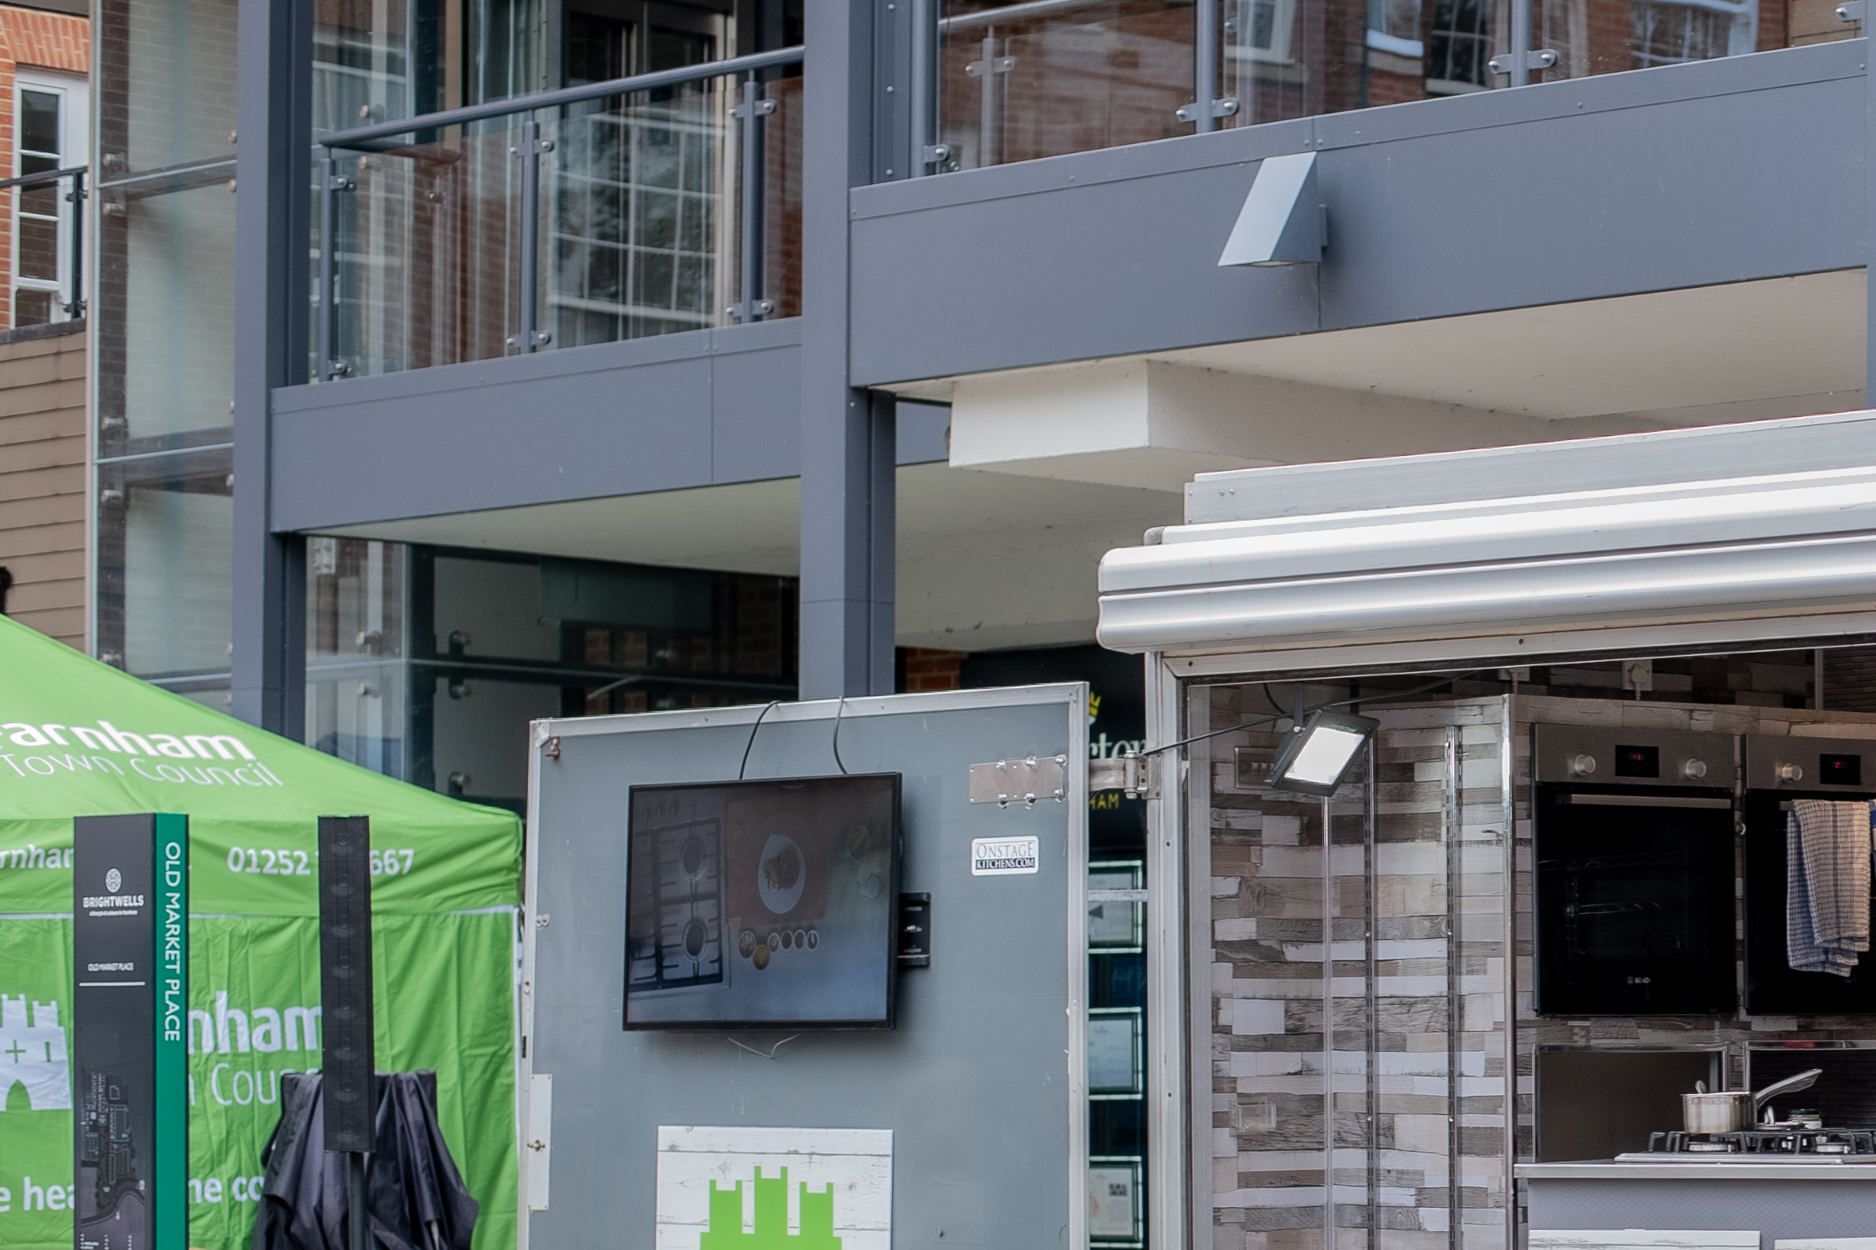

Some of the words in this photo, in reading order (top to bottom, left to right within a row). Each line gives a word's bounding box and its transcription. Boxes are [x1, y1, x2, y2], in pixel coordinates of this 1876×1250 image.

[0, 720, 256, 760] arnham
[0, 753, 125, 777] Town
[130, 758, 283, 787] Council
[165, 842, 182, 887] OLD
[227, 846, 311, 876] 01252
[976, 842, 1035, 858] ONSTAGE
[82, 894, 145, 908] BRIGHTWELLS
[164, 892, 181, 974] MARKET
[164, 979, 181, 1042] PLACE
